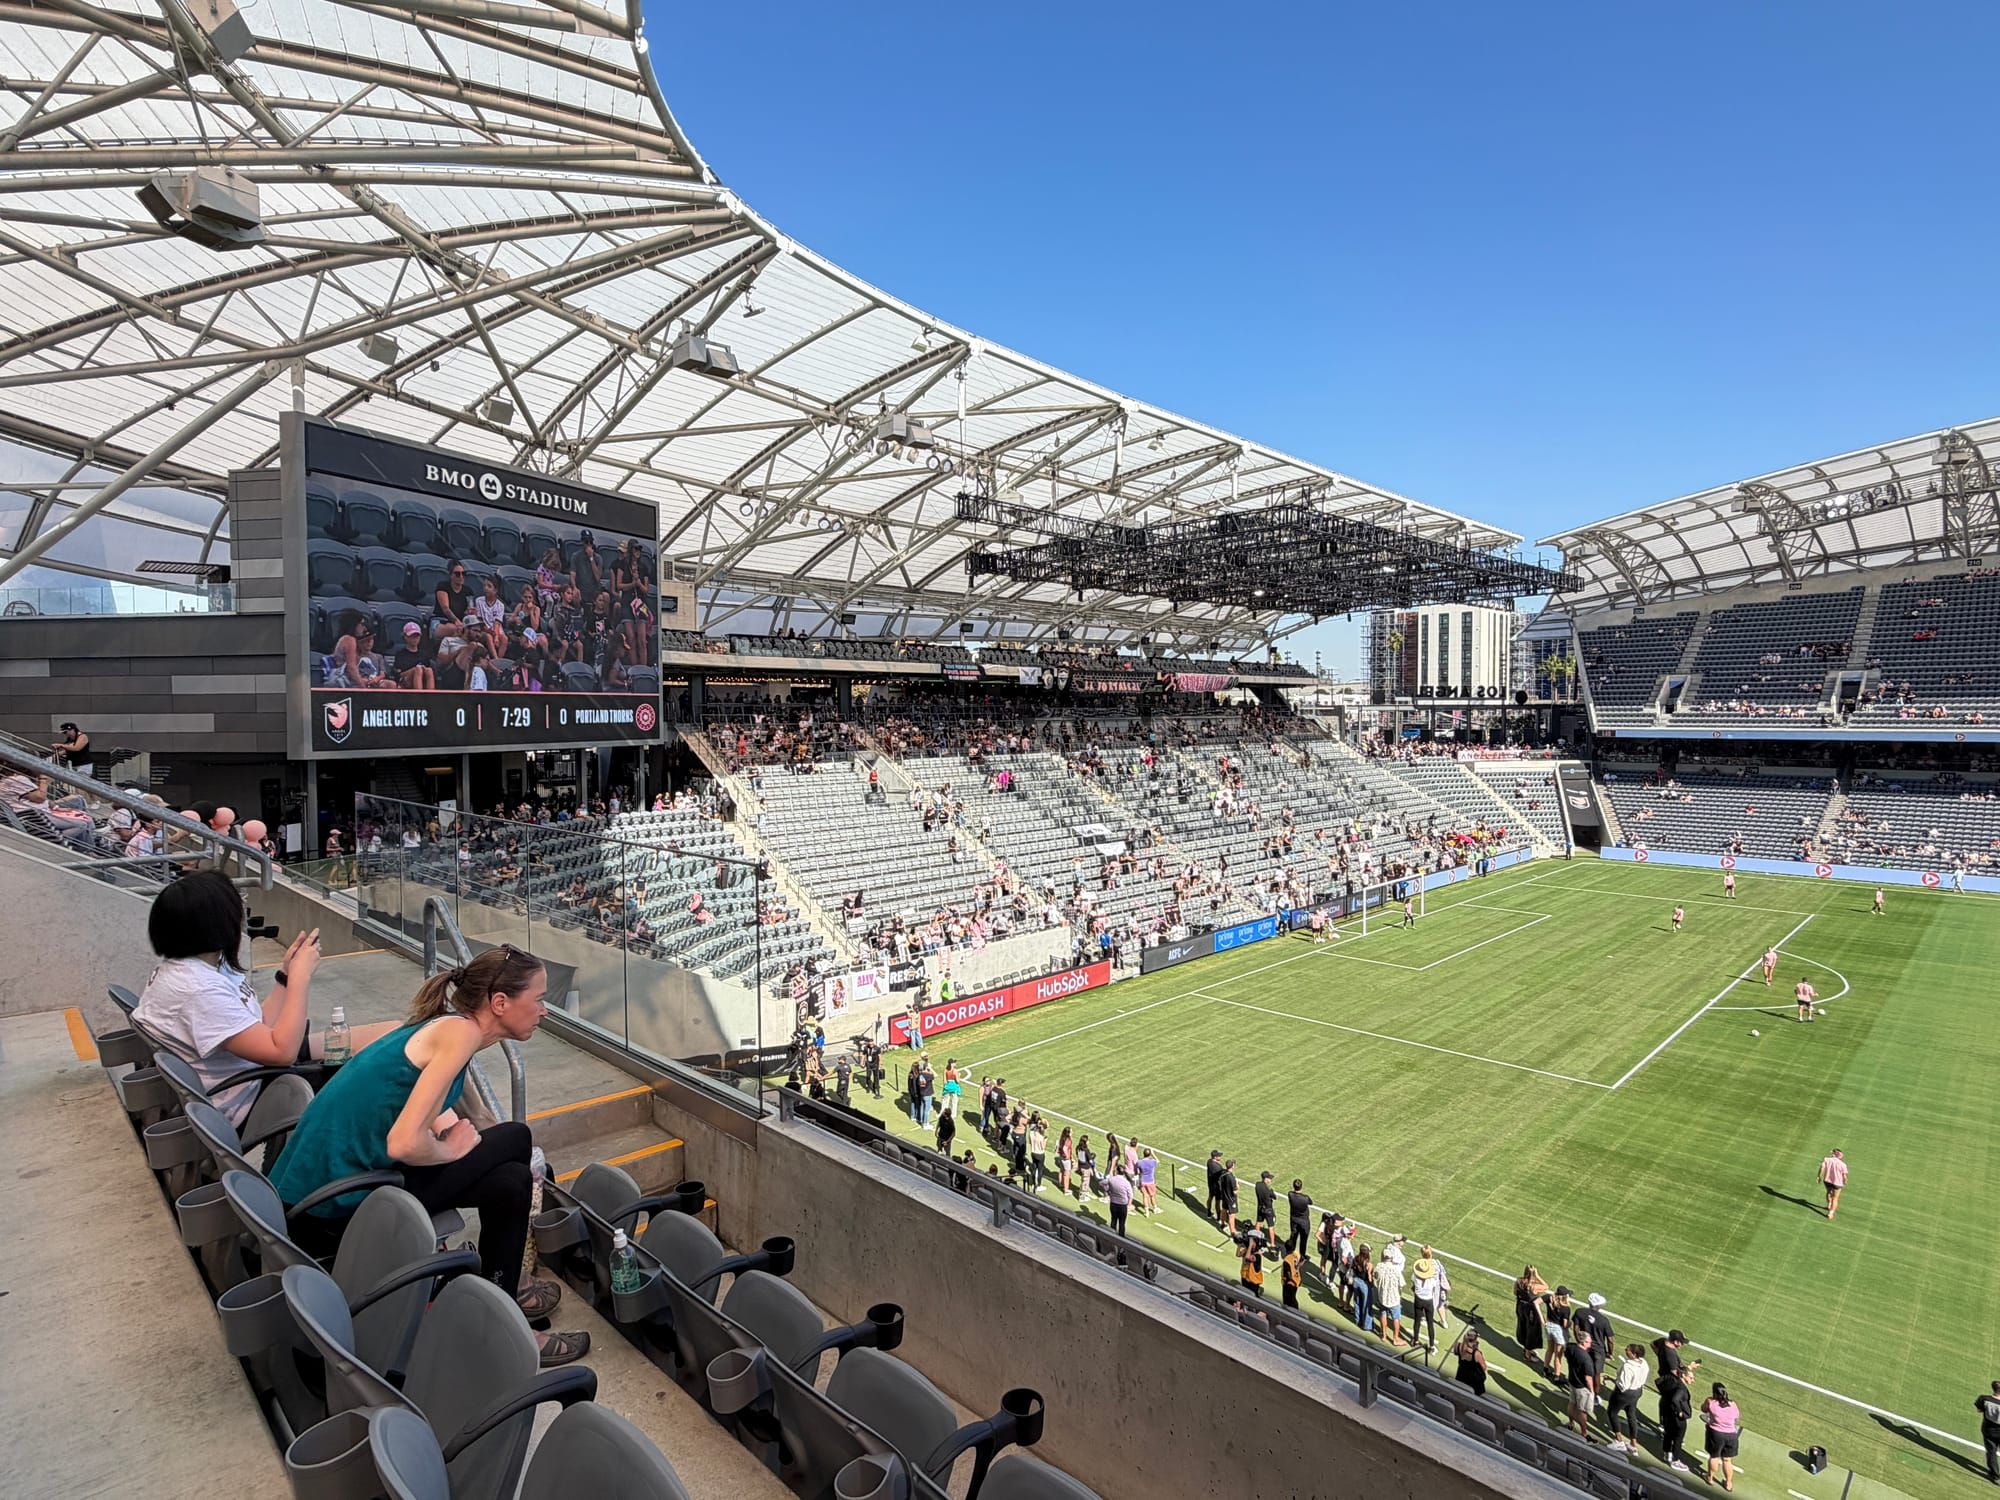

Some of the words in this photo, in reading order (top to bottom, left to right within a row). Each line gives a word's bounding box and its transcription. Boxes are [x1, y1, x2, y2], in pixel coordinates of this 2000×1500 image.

[425, 464, 475, 489] BMO
[505, 483, 588, 515] STADIUM
[362, 709, 393, 728] ANGEL
[394, 709, 416, 727] CITY
[417, 709, 428, 727] FC
[456, 708, 465, 727] 0
[501, 707, 531, 727] 7:29
[560, 708, 567, 725] 0
[575, 709, 608, 724] PORTLAND
[610, 709, 634, 723] THORNS
[1239, 926, 1254, 938] prime
[1257, 921, 1273, 933] prime
[1218, 931, 1234, 943] prime
[1037, 969, 1089, 999] HubSpot
[925, 996, 1004, 1030] DOORDASH
